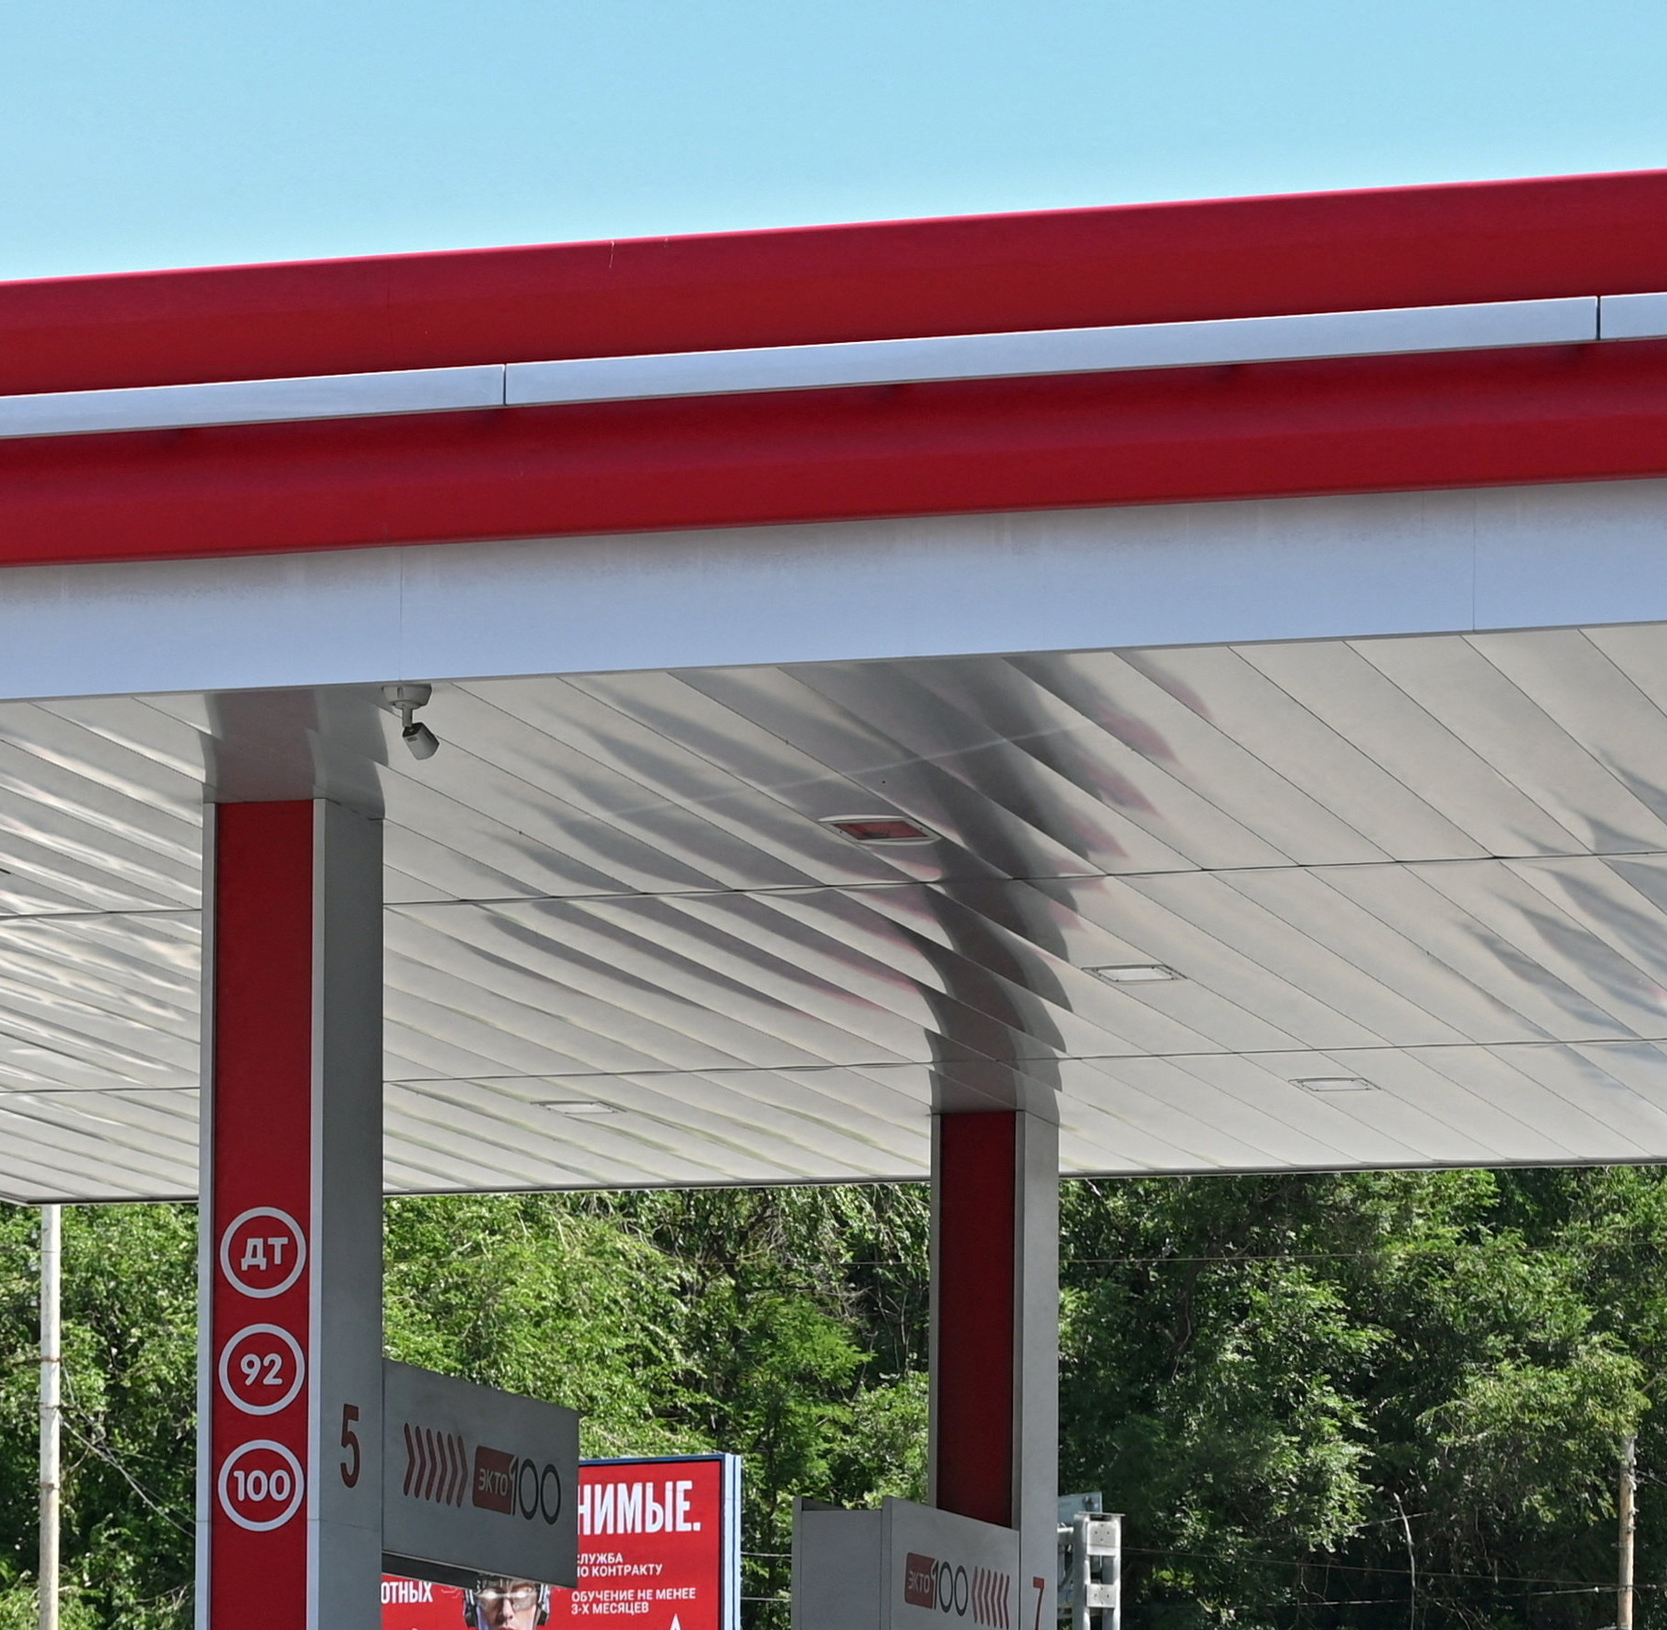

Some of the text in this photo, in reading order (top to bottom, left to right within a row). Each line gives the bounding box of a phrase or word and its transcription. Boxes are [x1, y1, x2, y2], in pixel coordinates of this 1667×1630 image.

[240, 1236, 289, 1272] ДТ
[240, 1352, 284, 1387] 92
[340, 1402, 361, 1490] 5
[232, 1468, 292, 1503] 100
[477, 1467, 509, 1497] ЭКТО
[592, 1563, 663, 1578] КОНТРАКТУ
[907, 1569, 931, 1594] ЭКТО
[570, 1601, 650, 1616] 3-Х МЕСЯЦЕВ
[571, 1587, 696, 1603] ОБУЧЕНИЕ НЕ МЕНЕЕ
